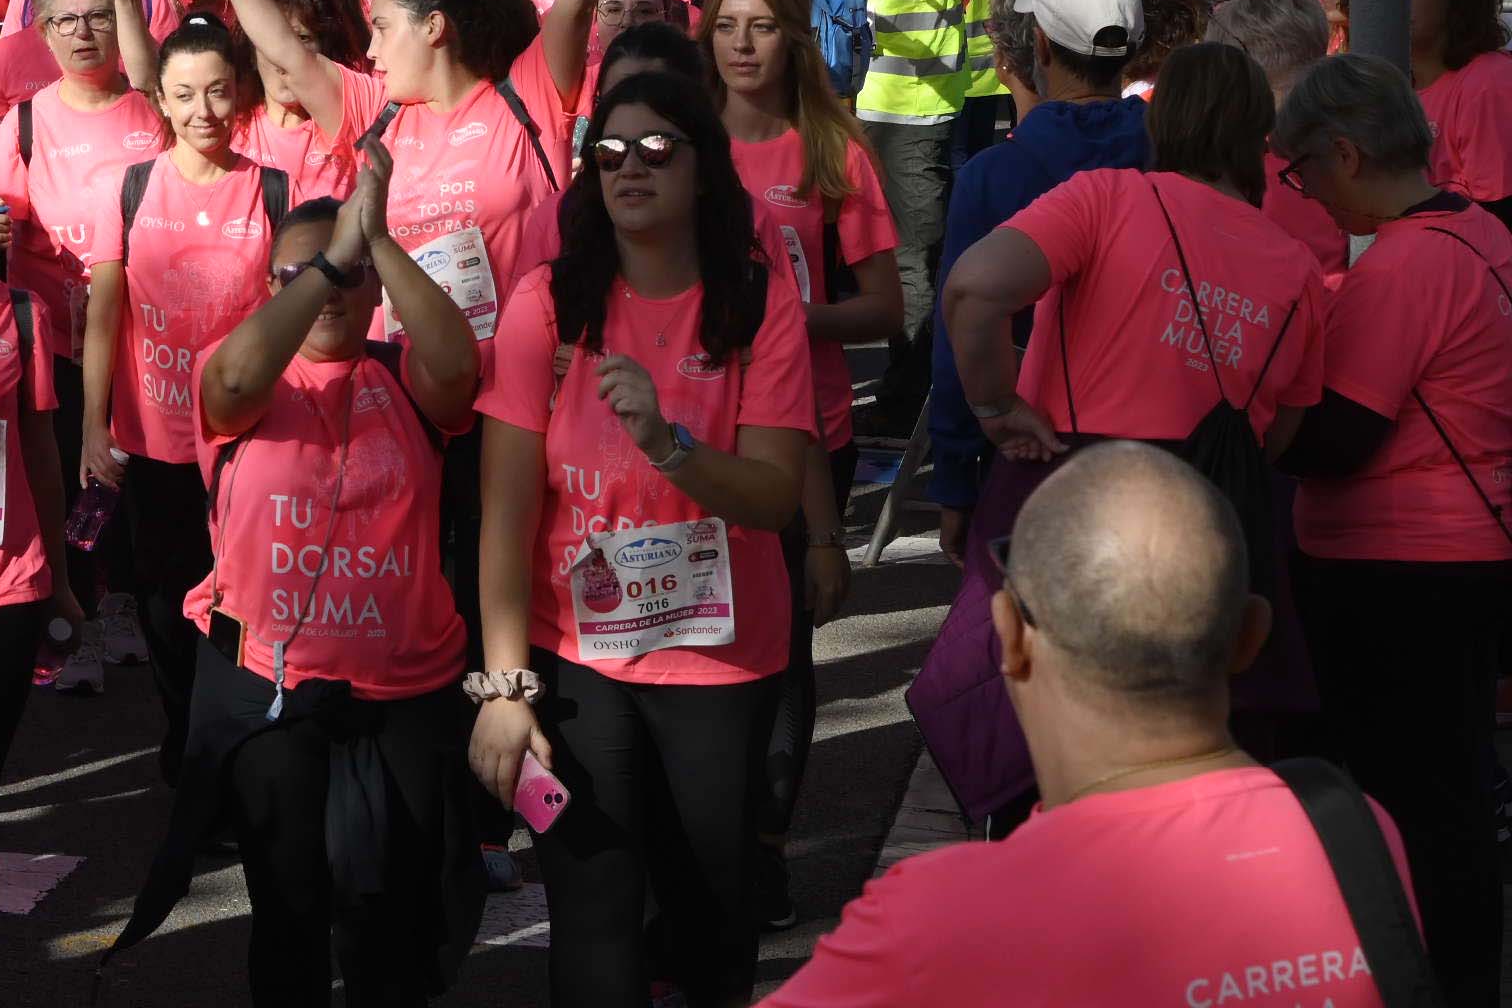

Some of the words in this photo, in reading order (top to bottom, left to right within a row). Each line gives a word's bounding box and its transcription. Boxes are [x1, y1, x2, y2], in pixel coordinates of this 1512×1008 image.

[440, 180, 476, 197] POR
[417, 200, 475, 218] TODAS
[51, 223, 87, 244] TU
[139, 216, 185, 233] OYSHO
[388, 220, 474, 238] NOSOTRAS
[1161, 269, 1269, 329] CARRERA
[140, 303, 167, 332] TU
[1214, 313, 1243, 344] LA
[143, 338, 194, 373] DOR
[144, 373, 192, 408] SUM
[562, 464, 601, 500] TU
[270, 494, 313, 529] TU
[271, 542, 413, 579] DORSAL
[620, 547, 677, 564] ASTURIANA
[627, 574, 678, 599] 016
[271, 589, 384, 625] SUMA
[595, 621, 638, 633] CARRERA
[639, 619, 651, 628] DE
[653, 615, 664, 624] LA
[666, 608, 694, 621] MUJER
[698, 606, 718, 616] 2023
[638, 598, 669, 614] 7016
[593, 639, 640, 651] OYSHO
[675, 626, 723, 637] Santander
[1185, 945, 1373, 1008] CARRERA
